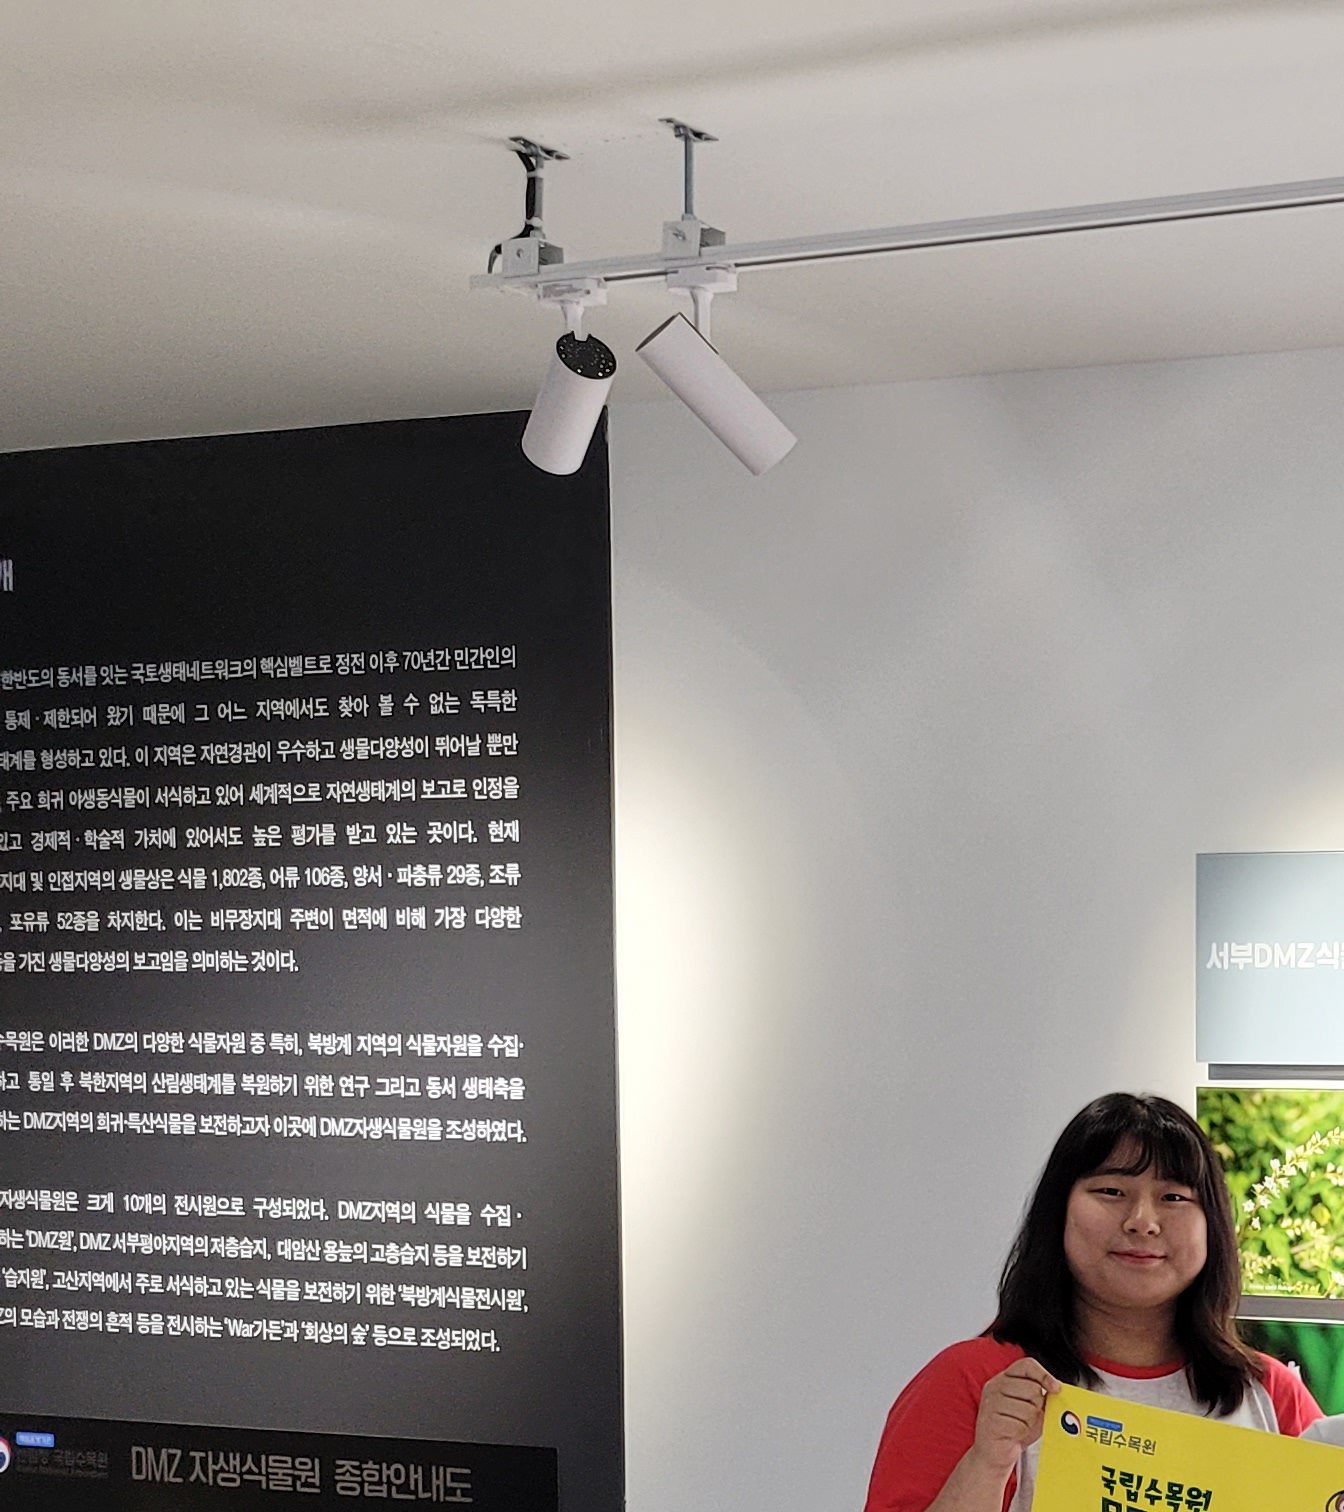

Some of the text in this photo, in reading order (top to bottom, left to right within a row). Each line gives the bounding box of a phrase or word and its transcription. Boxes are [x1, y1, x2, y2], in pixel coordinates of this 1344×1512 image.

[0, 646, 515, 689] 한반도의 동서를 잇는 국토생태네트워크의 핵심벨트로 정전 이후 70년간 민간인의
[41, 749, 95, 769] 형성하고
[99, 747, 130, 767] 있다.
[136, 746, 148, 766] 이
[154, 745, 196, 765] 지역은
[201, 741, 270, 764] 자연경관이
[277, 740, 335, 762] 우수하고
[340, 736, 428, 759] 생물다양성이
[435, 734, 481, 757] 뛰어날
[487, 733, 518, 755] 뿐만
[7, 777, 519, 811] 주요 희귀 야생동식물이 서식하고 있어 세계적으로 자연생태계의 보고로 인정을
[31, 871, 43, 891] 및
[48, 870, 115, 891] 인접지역의
[119, 869, 174, 890] 생물상은
[178, 868, 207, 889] 식물
[212, 868, 265, 890] 1,802종,
[270, 867, 300, 888] 어류
[305, 866, 348, 888] 106종,
[353, 865, 382, 887] 양서
[397, 864, 443, 886] 파충류
[447, 864, 484, 887] 29종,
[489, 863, 521, 885] 조류
[10, 906, 522, 932] 포유류 52종을 차지한다. 이는 비무장지대 주변이 면적에 비해 가장 다양한
[24, 1111, 93, 1132] DMZ지역의
[199, 1114, 270, 1136] 보전하고자
[274, 1116, 316, 1137] 이곳에
[320, 1117, 443, 1140] DMZ자생식물원을
[446, 1119, 526, 1142] 조성하였다.
[87, 1192, 113, 1213] 크게
[123, 1193, 166, 1214] 10개의
[174, 1195, 245, 1216] 전시원으로
[253, 1198, 328, 1220] 구성되었다.
[338, 1201, 415, 1223] DMZ지역의
[424, 1203, 471, 1225] 식물을
[480, 1204, 511, 1226] 수집
[80, 1233, 111, 1250] DMZ
[113, 1233, 208, 1256] 서부평야지역의
[211, 1236, 271, 1260] 저층습지,
[277, 1239, 321, 1260] 대암산
[323, 1241, 367, 1263] 용늪의
[370, 1243, 429, 1265] 고층습지
[433, 1245, 464, 1266] 등을
[466, 1246, 526, 1269] 보전하기
[52, 1271, 131, 1293] 고산지역에서
[136, 1273, 164, 1294] 주로
[166, 1275, 223, 1296] 서식하고
[225, 1277, 254, 1298] 있는
[256, 1279, 301, 1300] 식물을
[304, 1281, 360, 1304] 보전하기
[366, 1284, 396, 1305] 위한
[1086, 1426, 1156, 1455] 국립수목원
[131, 1445, 184, 1483] DMZ
[189, 1451, 321, 1494] 자생식물원
[334, 1459, 473, 1503] 종합안내도
